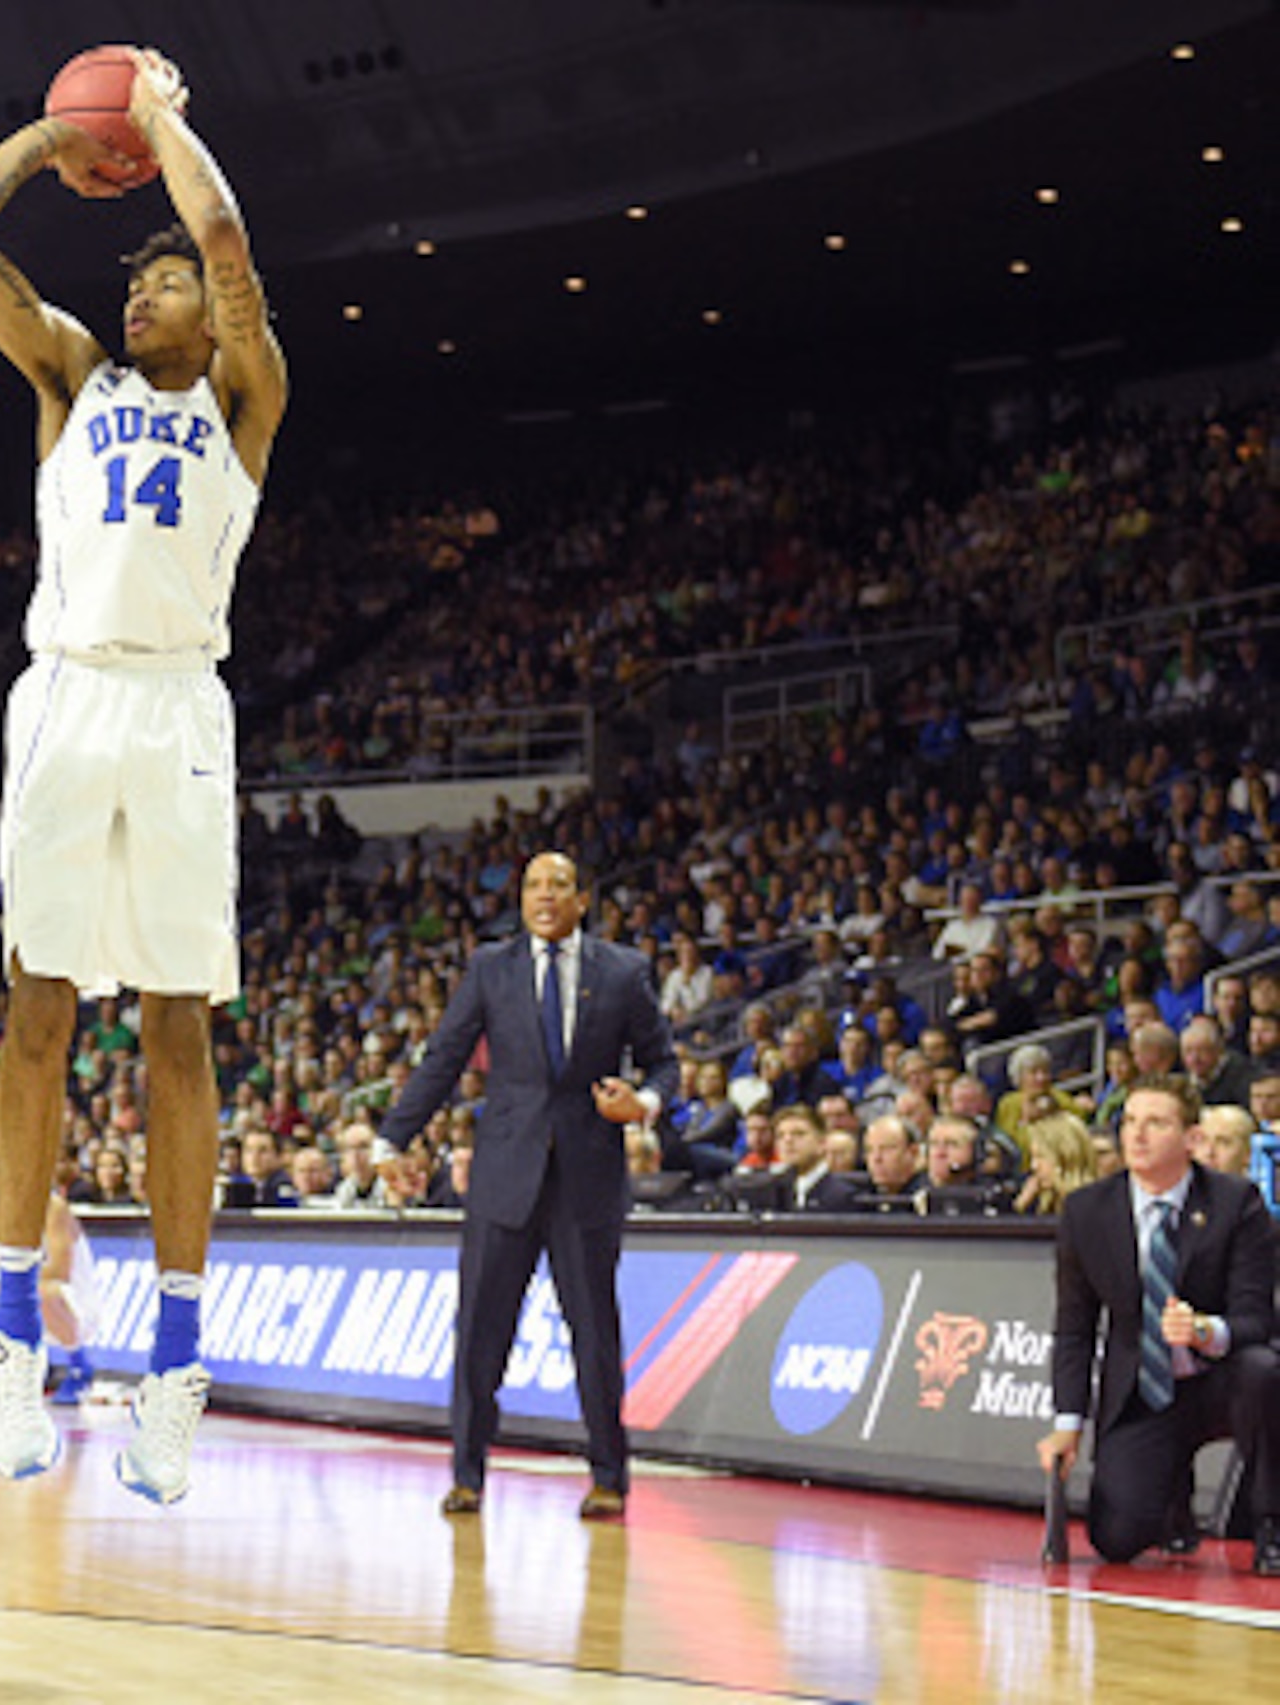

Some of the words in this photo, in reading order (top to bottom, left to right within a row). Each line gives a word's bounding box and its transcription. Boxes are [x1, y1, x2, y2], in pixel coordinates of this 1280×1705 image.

[86, 405, 214, 457] DUKE
[102, 455, 183, 527] 14
[774, 1343, 869, 1394] NCAA
